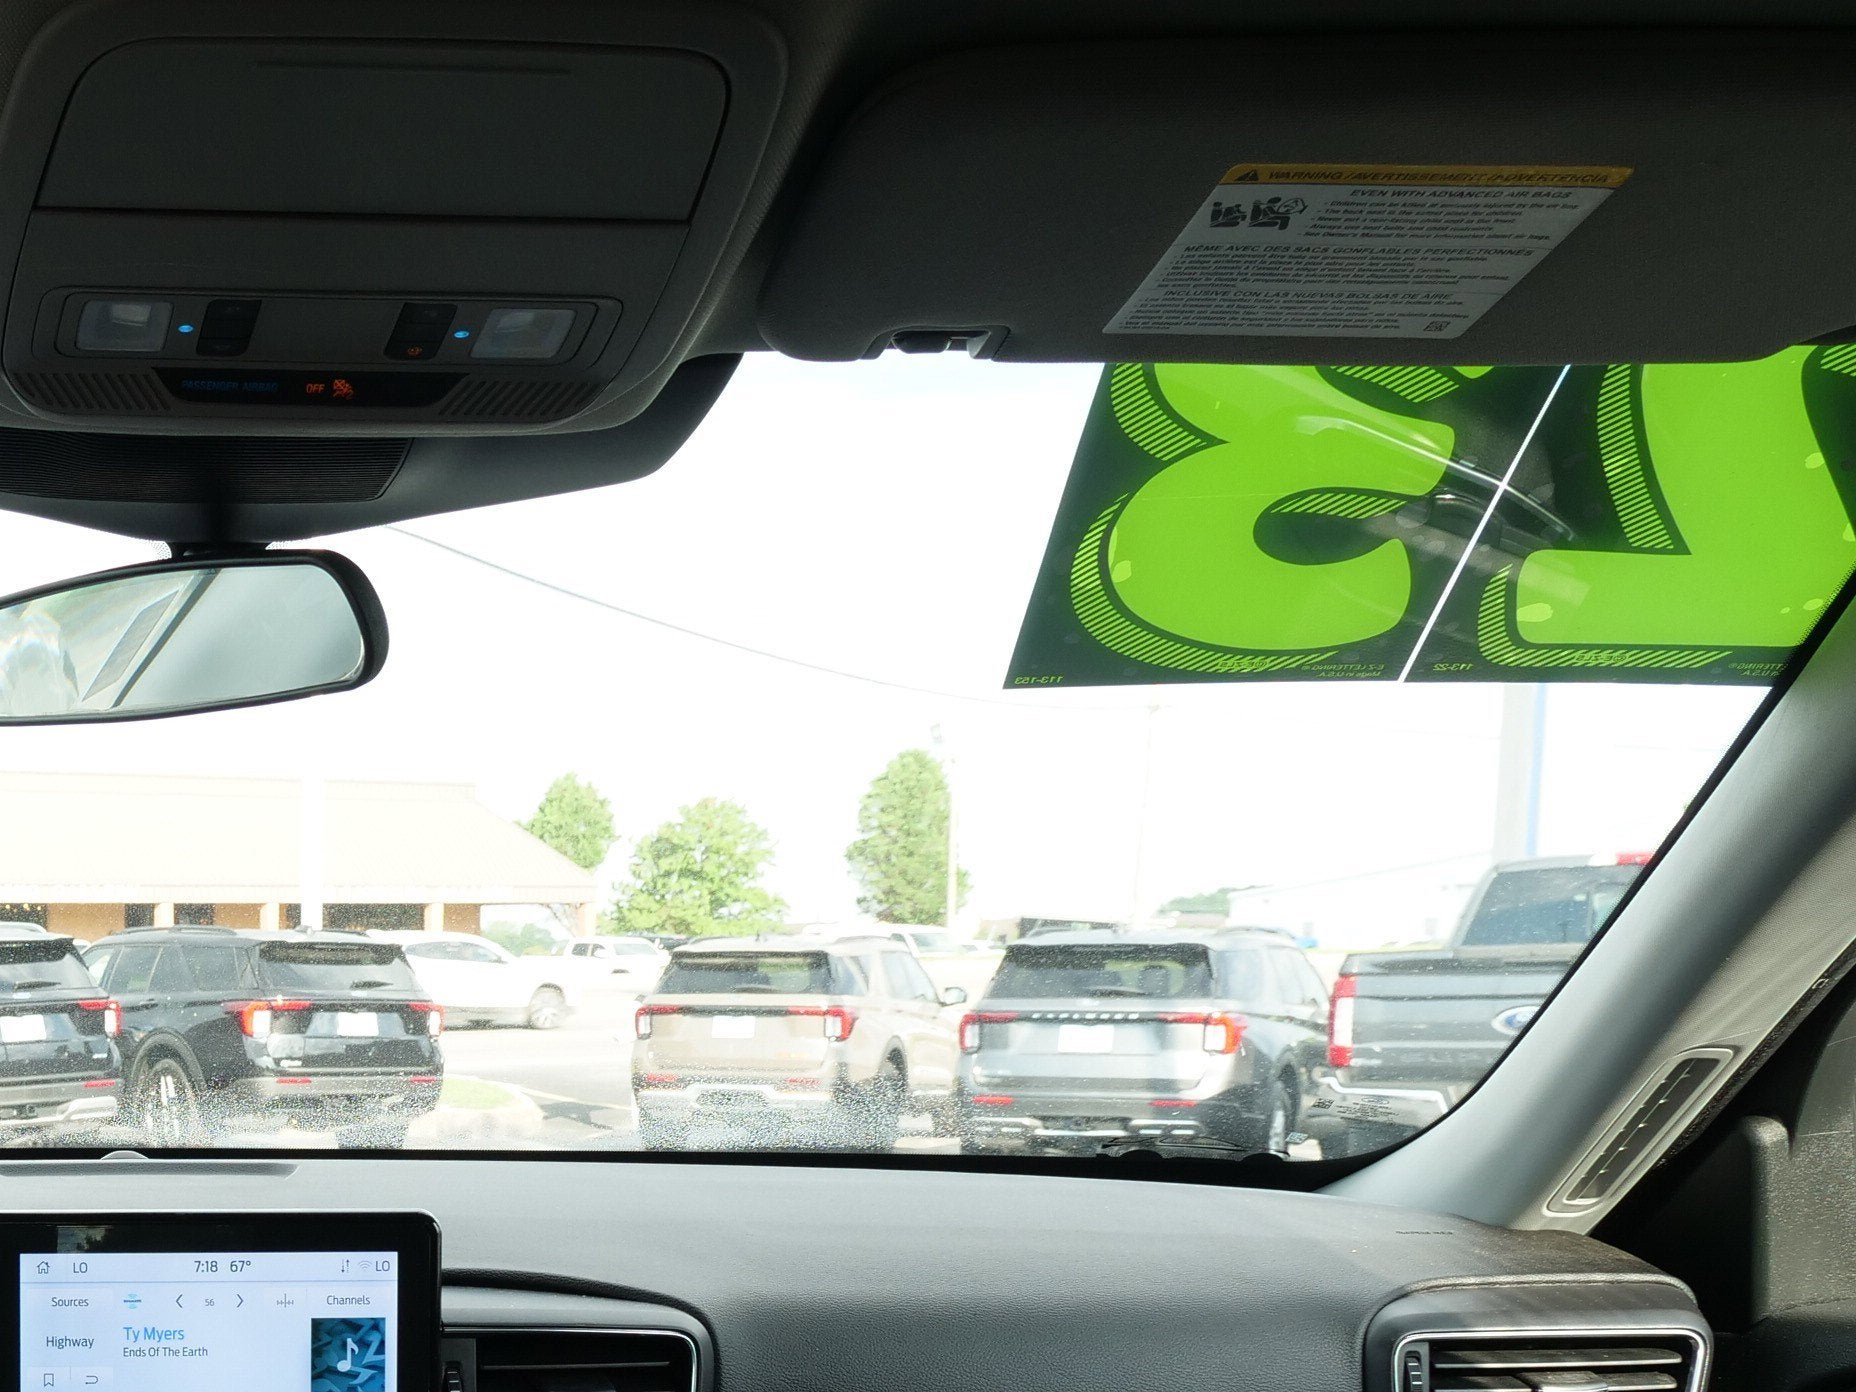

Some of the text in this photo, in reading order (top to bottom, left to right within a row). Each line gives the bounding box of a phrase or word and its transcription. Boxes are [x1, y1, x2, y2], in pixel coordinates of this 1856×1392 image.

[1350, 189, 1387, 197] EVEN
[1390, 189, 1425, 197] WITH
[1425, 190, 1507, 198] ADVANCED
[1531, 191, 1572, 199] BAGS
[306, 383, 325, 393] OFF
[73, 1262, 88, 1274] LO
[194, 1260, 252, 1273] 7:18 67°
[375, 1260, 391, 1272] LO
[51, 1296, 89, 1307] Sources
[204, 1298, 215, 1307] 56
[326, 1294, 371, 1306] Channels
[123, 1326, 185, 1342] Ty Myers
[46, 1336, 94, 1350] Highway
[123, 1347, 209, 1357] Ends Of The Earth
